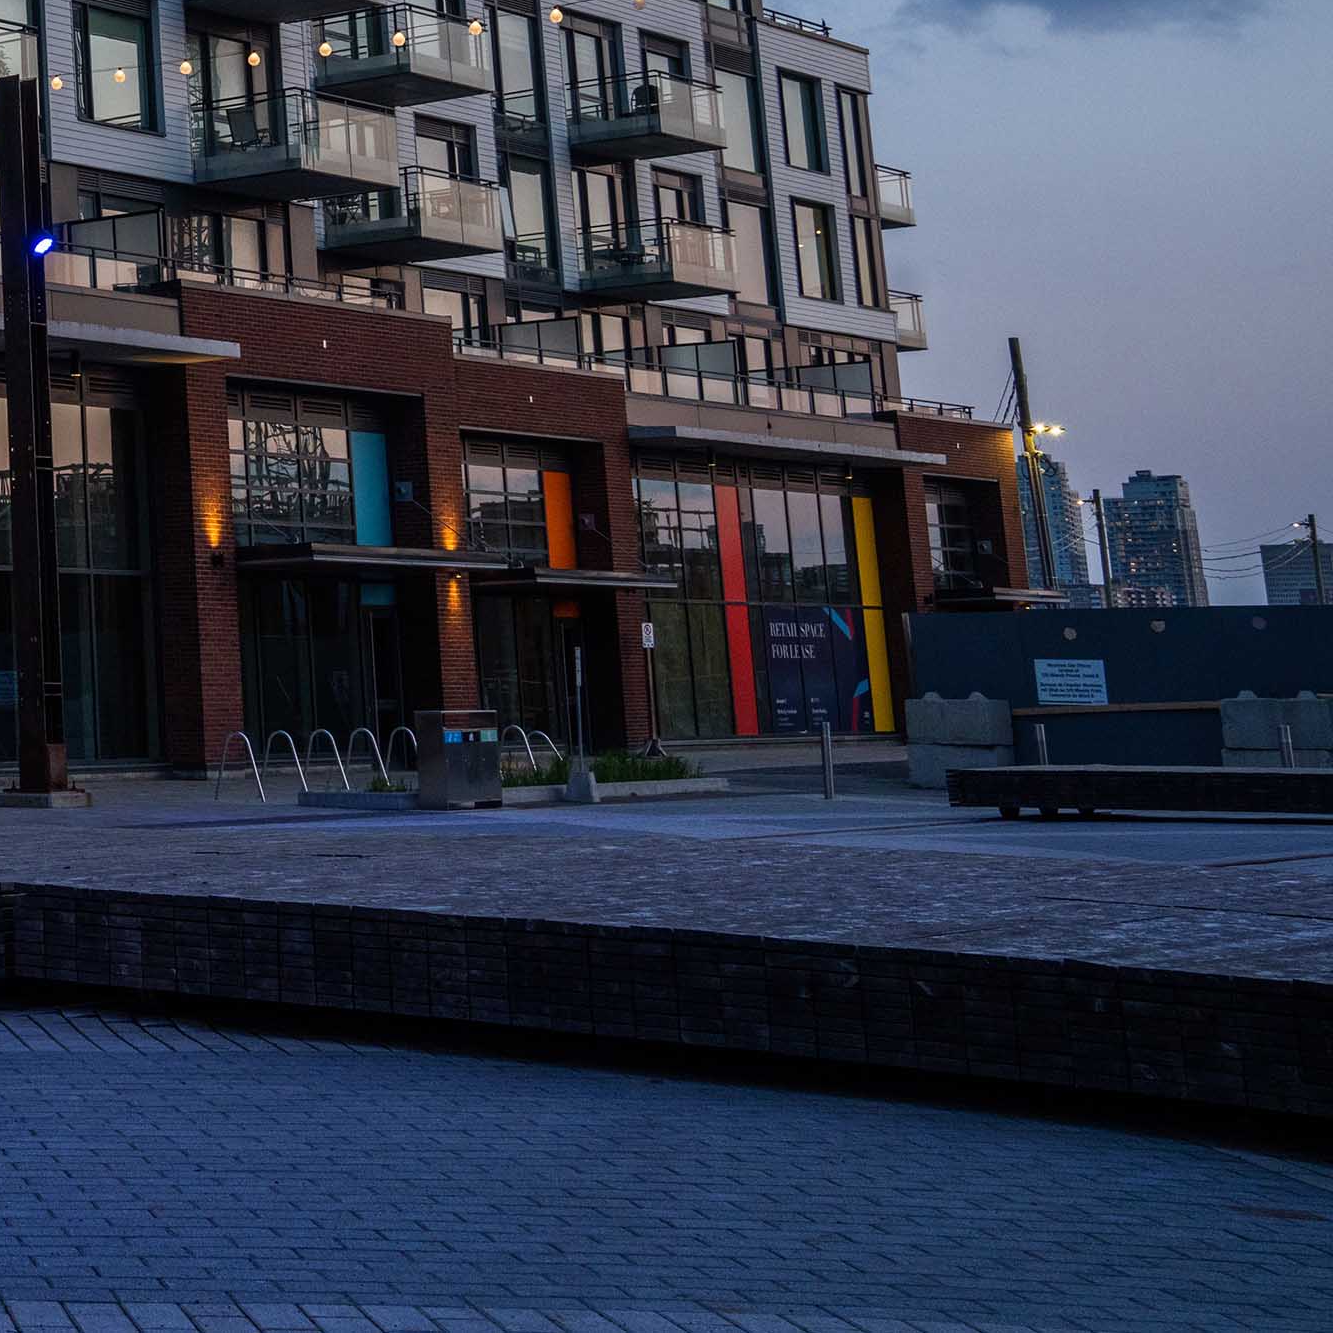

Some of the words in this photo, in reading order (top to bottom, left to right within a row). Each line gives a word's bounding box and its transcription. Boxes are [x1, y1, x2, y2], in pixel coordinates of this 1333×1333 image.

[769, 622, 798, 637] RETAIL
[798, 623, 825, 638] SPACE
[772, 644, 789, 658] FOR
[789, 644, 815, 658] LEASE
